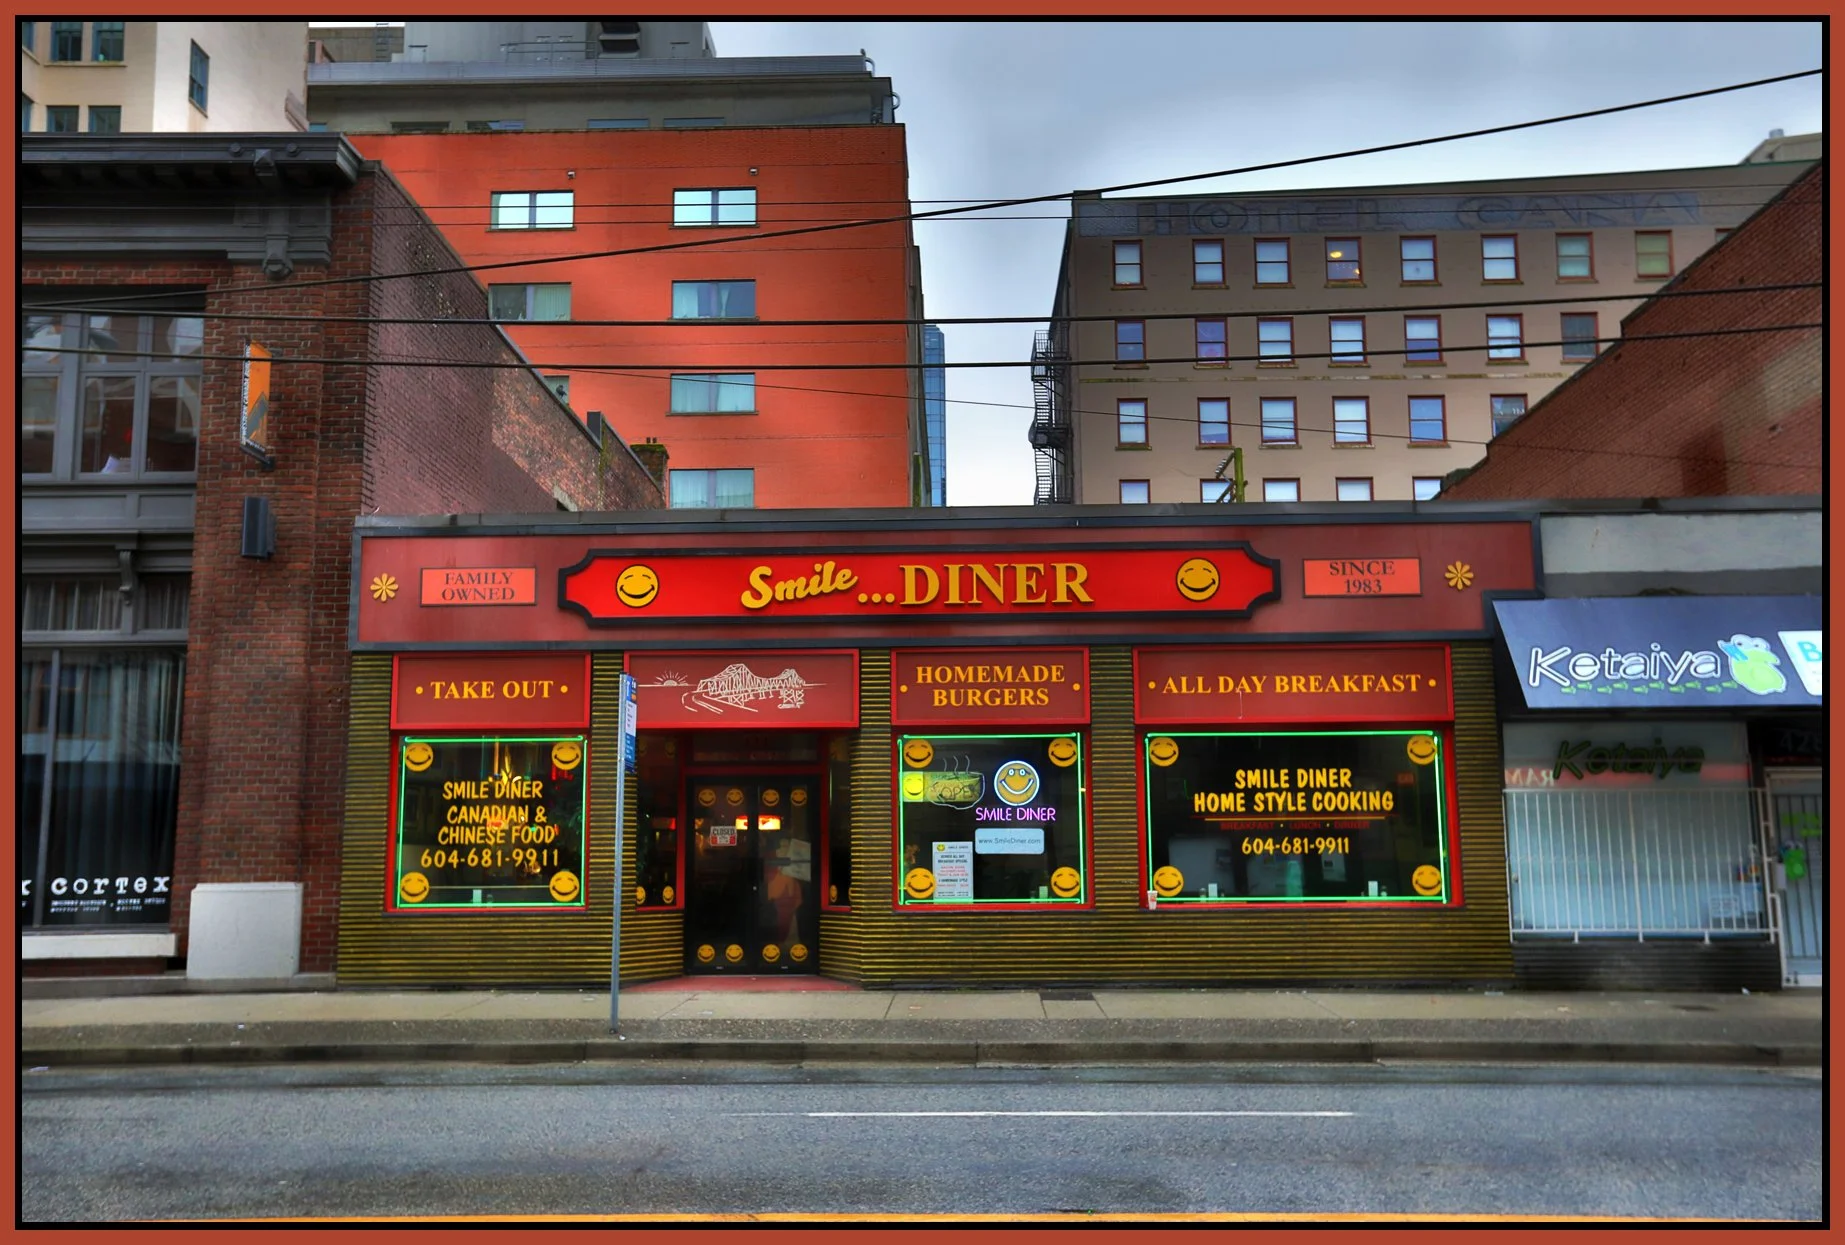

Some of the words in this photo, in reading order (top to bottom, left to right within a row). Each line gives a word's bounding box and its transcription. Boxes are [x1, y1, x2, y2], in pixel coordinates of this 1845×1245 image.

[1137, 198, 1407, 235] HOTEL
[444, 571, 514, 586] FAMILY
[1328, 560, 1395, 577] SINCE
[441, 586, 516, 602] OWNED
[740, 560, 858, 610] Smile
[1343, 578, 1383, 595] 1983
[915, 664, 1065, 684] HOMEMADE
[1528, 642, 1720, 687] Ketaiya
[430, 680, 496, 700] TAKE
[502, 680, 554, 700] OUT
[1162, 674, 1213, 694] ALL
[1218, 674, 1266, 694] DAY
[1274, 673, 1421, 694] BREAKFAST
[932, 686, 1050, 707] BURGERS
[1235, 769, 1290, 789] SMILE
[1297, 768, 1352, 788] DINER
[442, 780, 489, 800] SMILE
[494, 780, 543, 799] DINER
[1194, 792, 1246, 813] HOME
[1253, 791, 1307, 812] STYLE
[1312, 790, 1394, 812] COOKING
[446, 805, 529, 825] CANADIAN
[534, 807, 548, 823] &
[975, 807, 1012, 822] SMILE
[1016, 807, 1056, 822] DINER
[437, 825, 506, 846] CHINESE
[511, 825, 555, 845] FOOD
[1241, 837, 1350, 855] 604-681-9911
[420, 848, 559, 869] 604-681-9911
